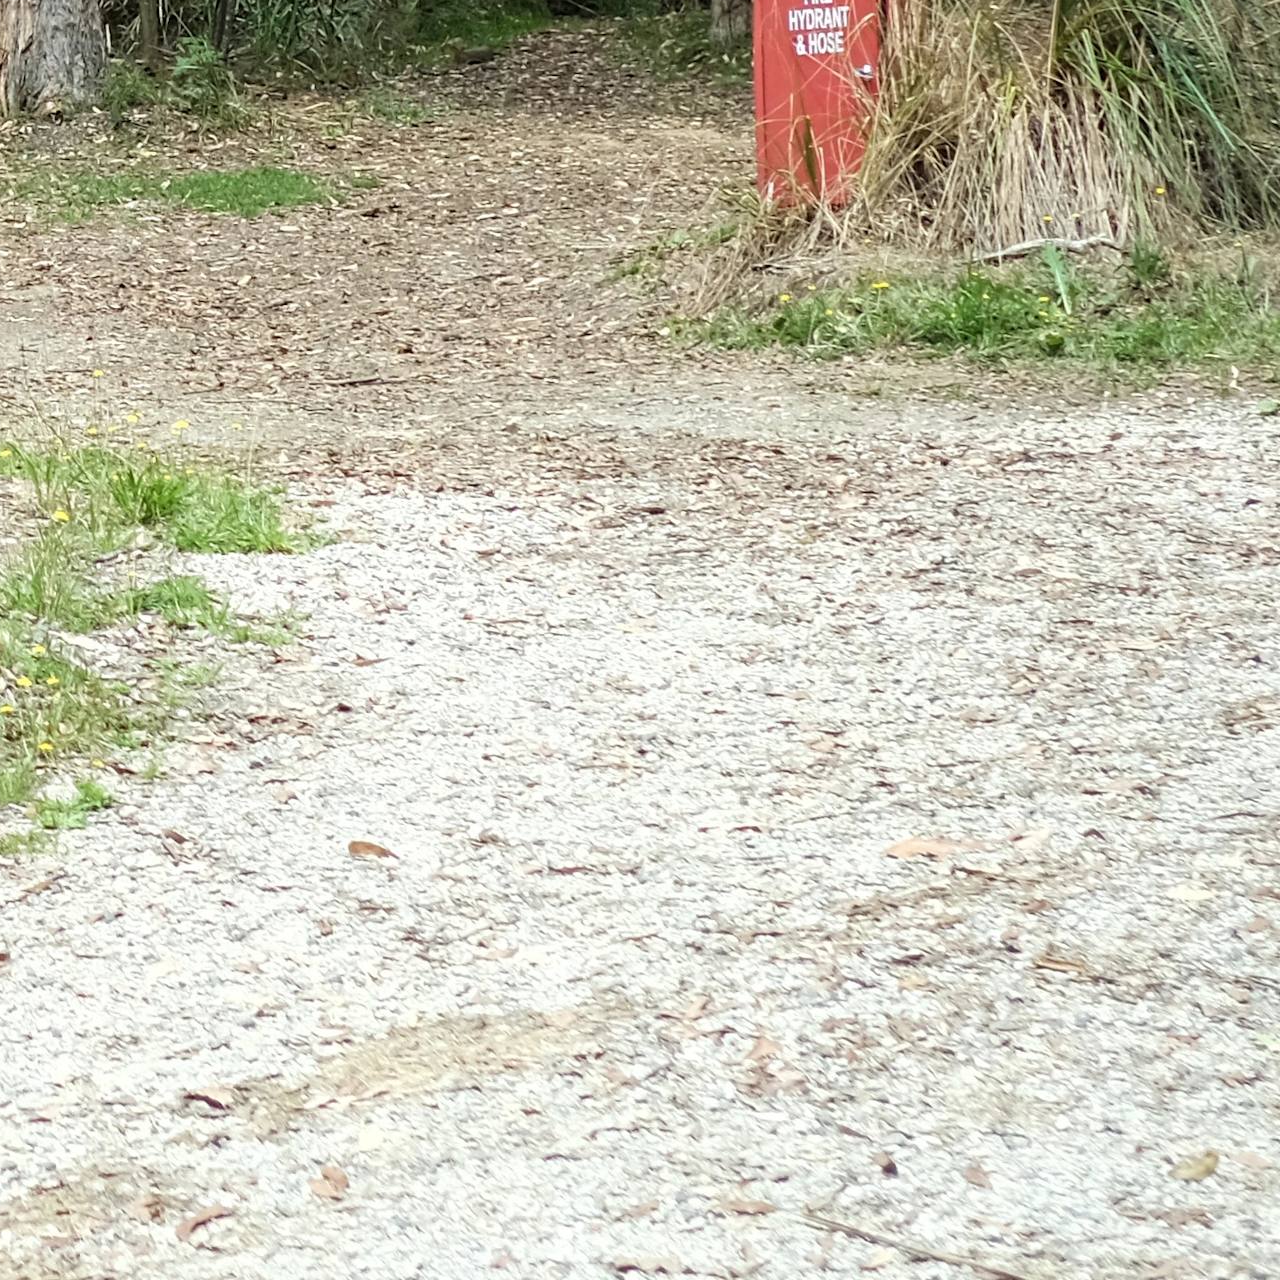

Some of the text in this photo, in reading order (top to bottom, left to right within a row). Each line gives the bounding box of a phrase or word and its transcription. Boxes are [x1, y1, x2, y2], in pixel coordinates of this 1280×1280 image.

[788, 6, 850, 31] HYDRANT
[796, 31, 845, 55] & HOSE
